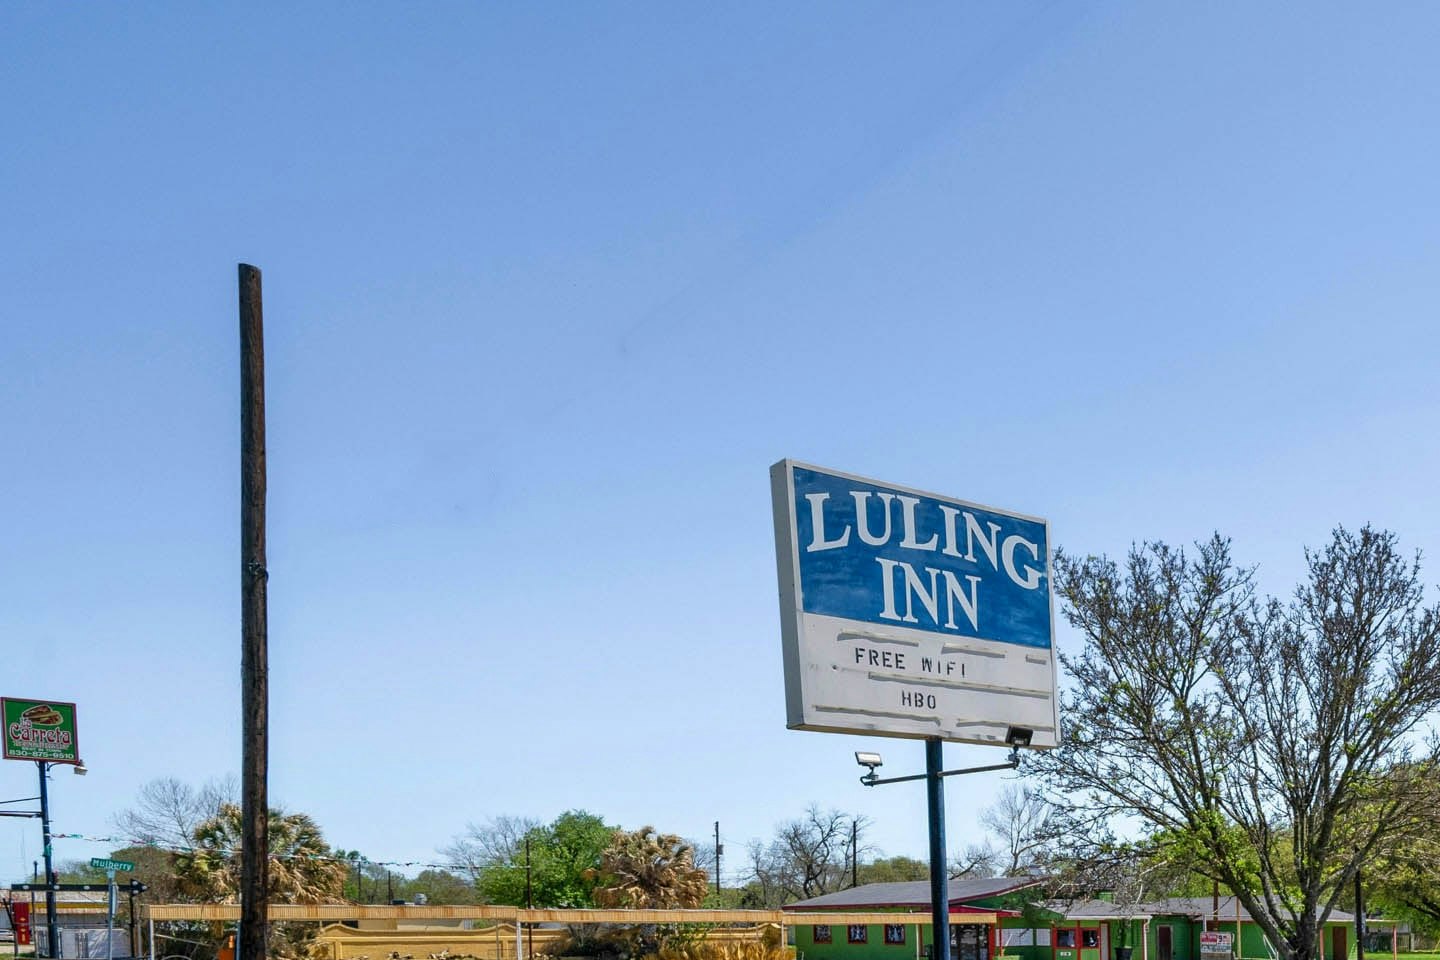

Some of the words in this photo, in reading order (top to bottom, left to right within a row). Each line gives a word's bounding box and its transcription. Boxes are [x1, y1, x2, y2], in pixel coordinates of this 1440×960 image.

[804, 490, 1043, 590] LULING
[875, 556, 982, 632] INN
[855, 647, 906, 670] FREE
[921, 657, 966, 678] WIFI
[901, 689, 937, 710] HBO
[10, 723, 72, 745] Carreta
[92, 860, 132, 871] Mulberry
